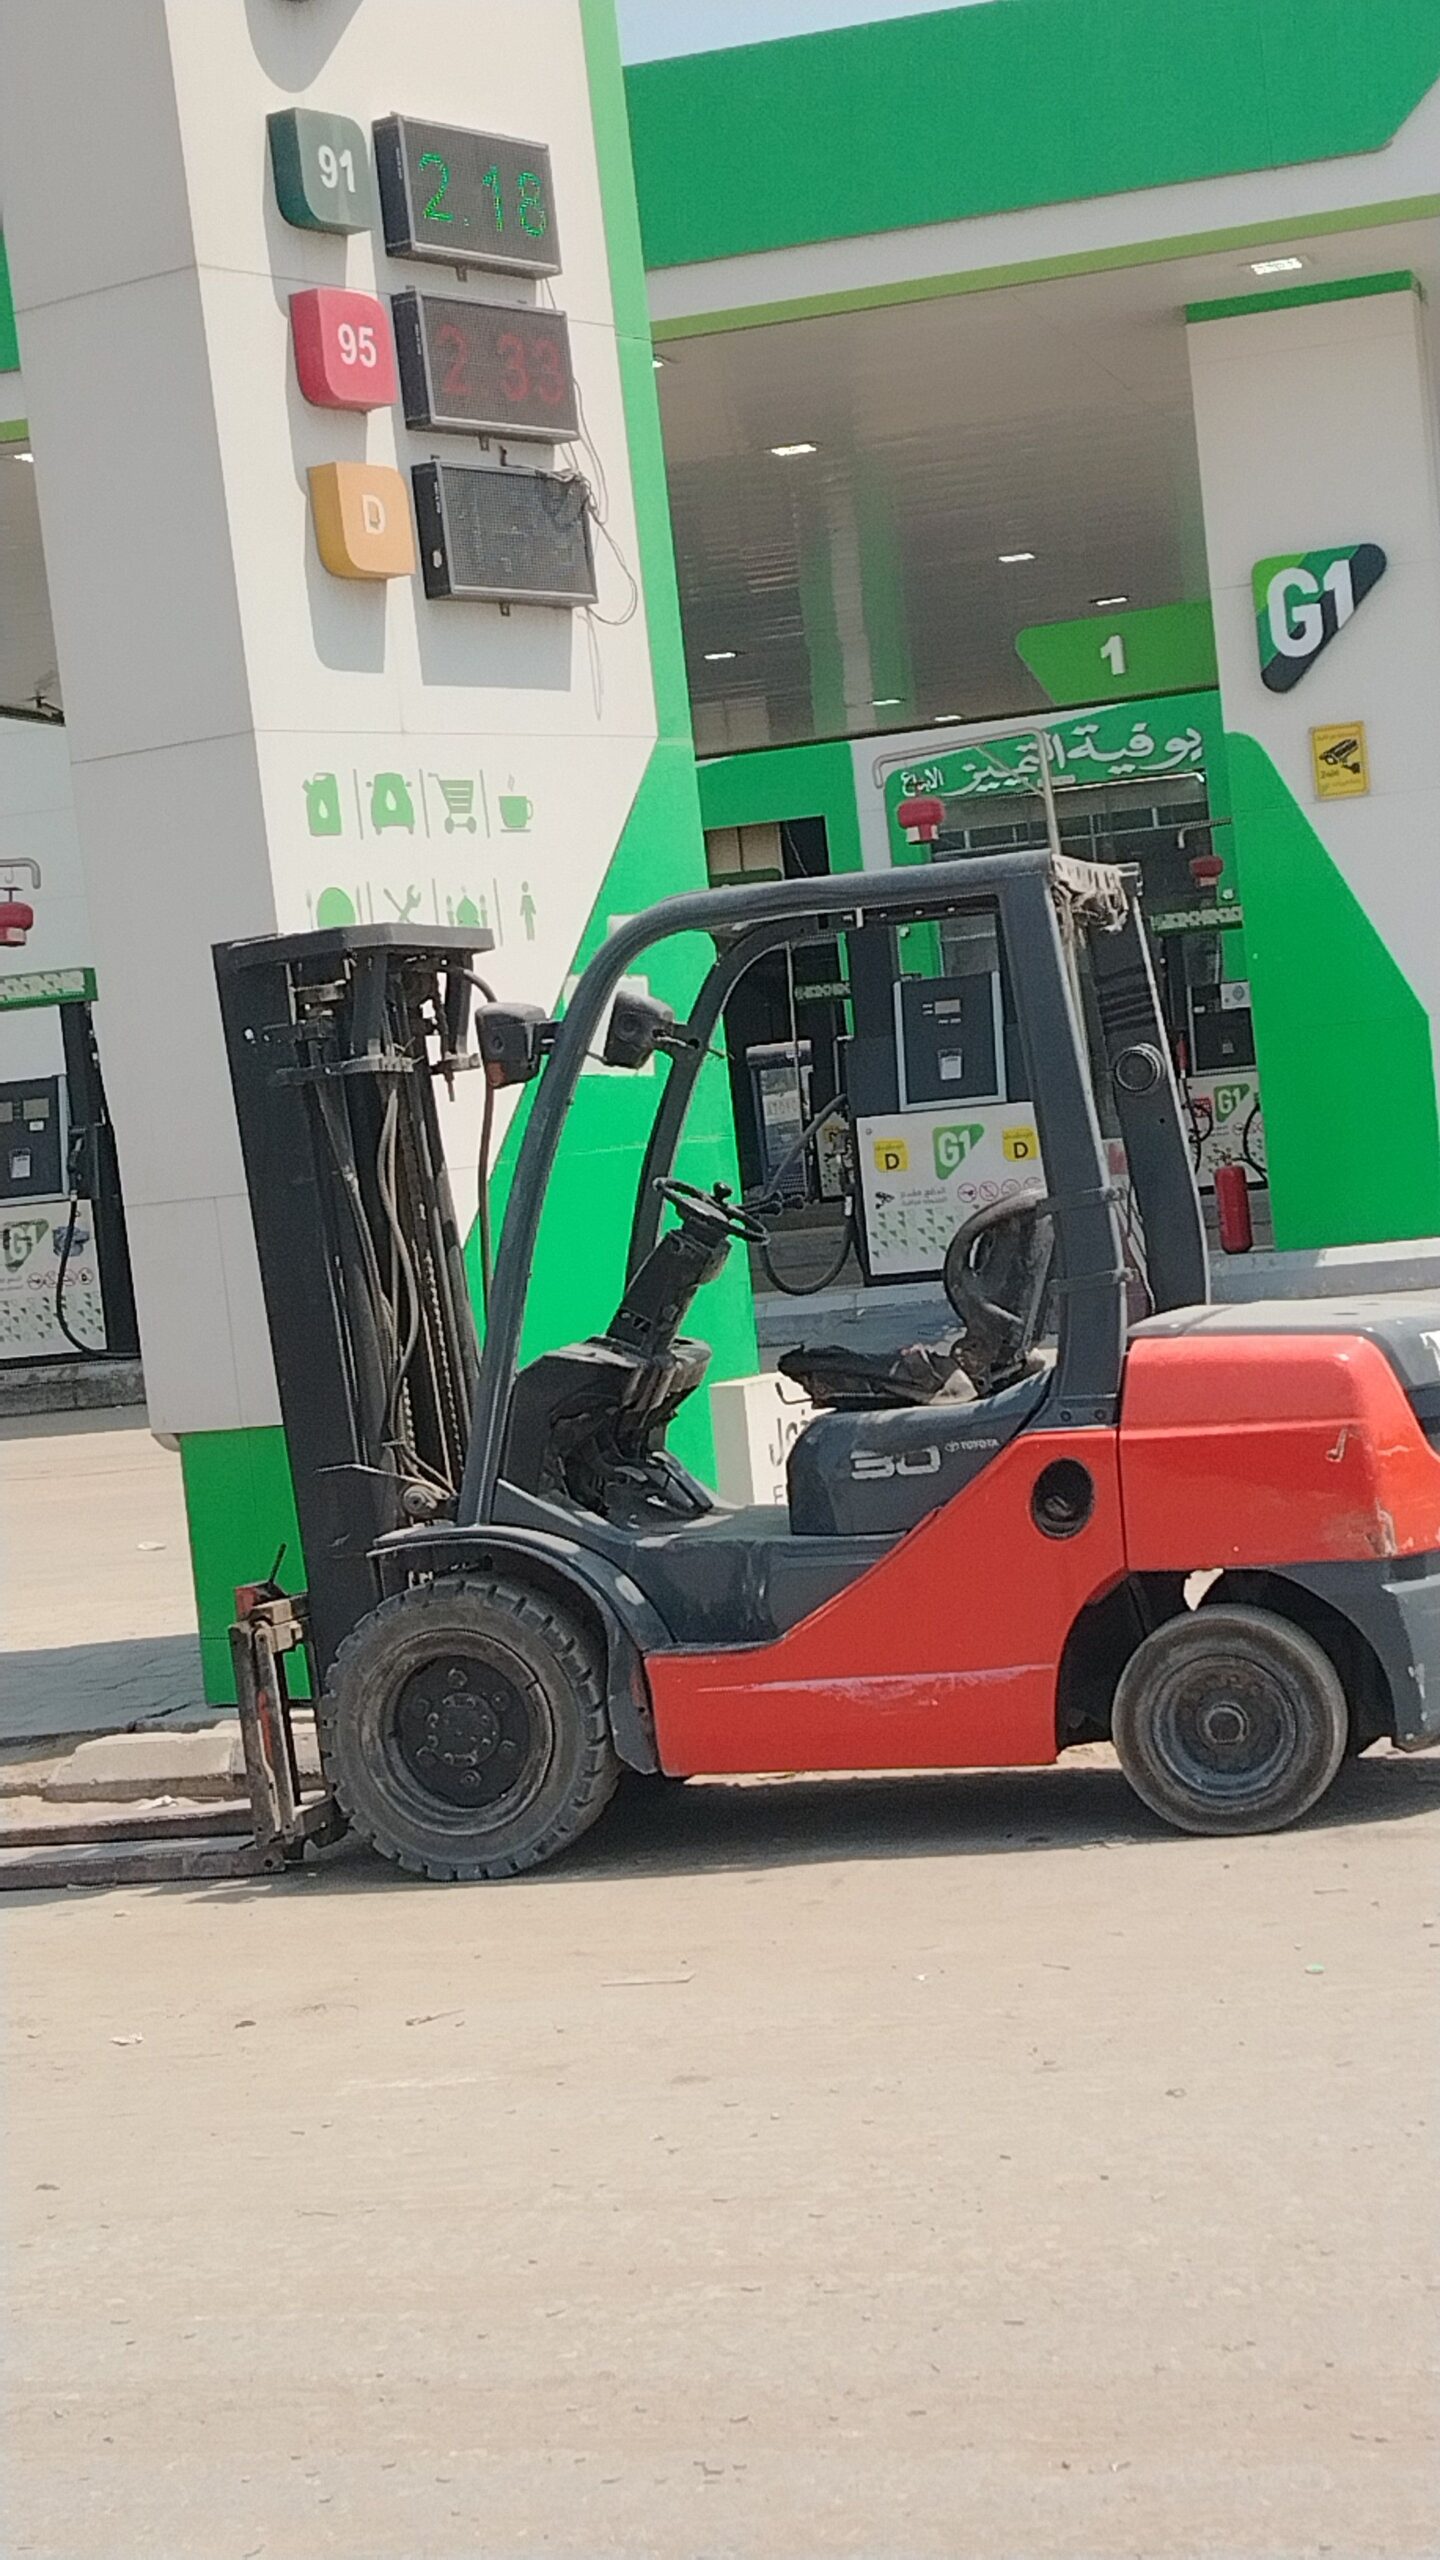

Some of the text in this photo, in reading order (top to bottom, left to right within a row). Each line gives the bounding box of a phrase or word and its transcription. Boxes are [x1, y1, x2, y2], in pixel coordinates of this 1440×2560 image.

[318, 145, 356, 193] 91
[419, 152, 547, 237] 2.18
[337, 323, 377, 367] 95
[362, 494, 386, 534] D
[1267, 559, 1354, 658] G1
[1100, 634, 1126, 675] 1
[1218, 1088, 1241, 1114] G1
[885, 1153, 900, 1170] D
[938, 1129, 971, 1168] G1
[1013, 1142, 1029, 1159] D
[9, 1225, 38, 1260] G1
[851, 1446, 941, 1480] 30
[961, 1438, 1000, 1450] TOYOTA
